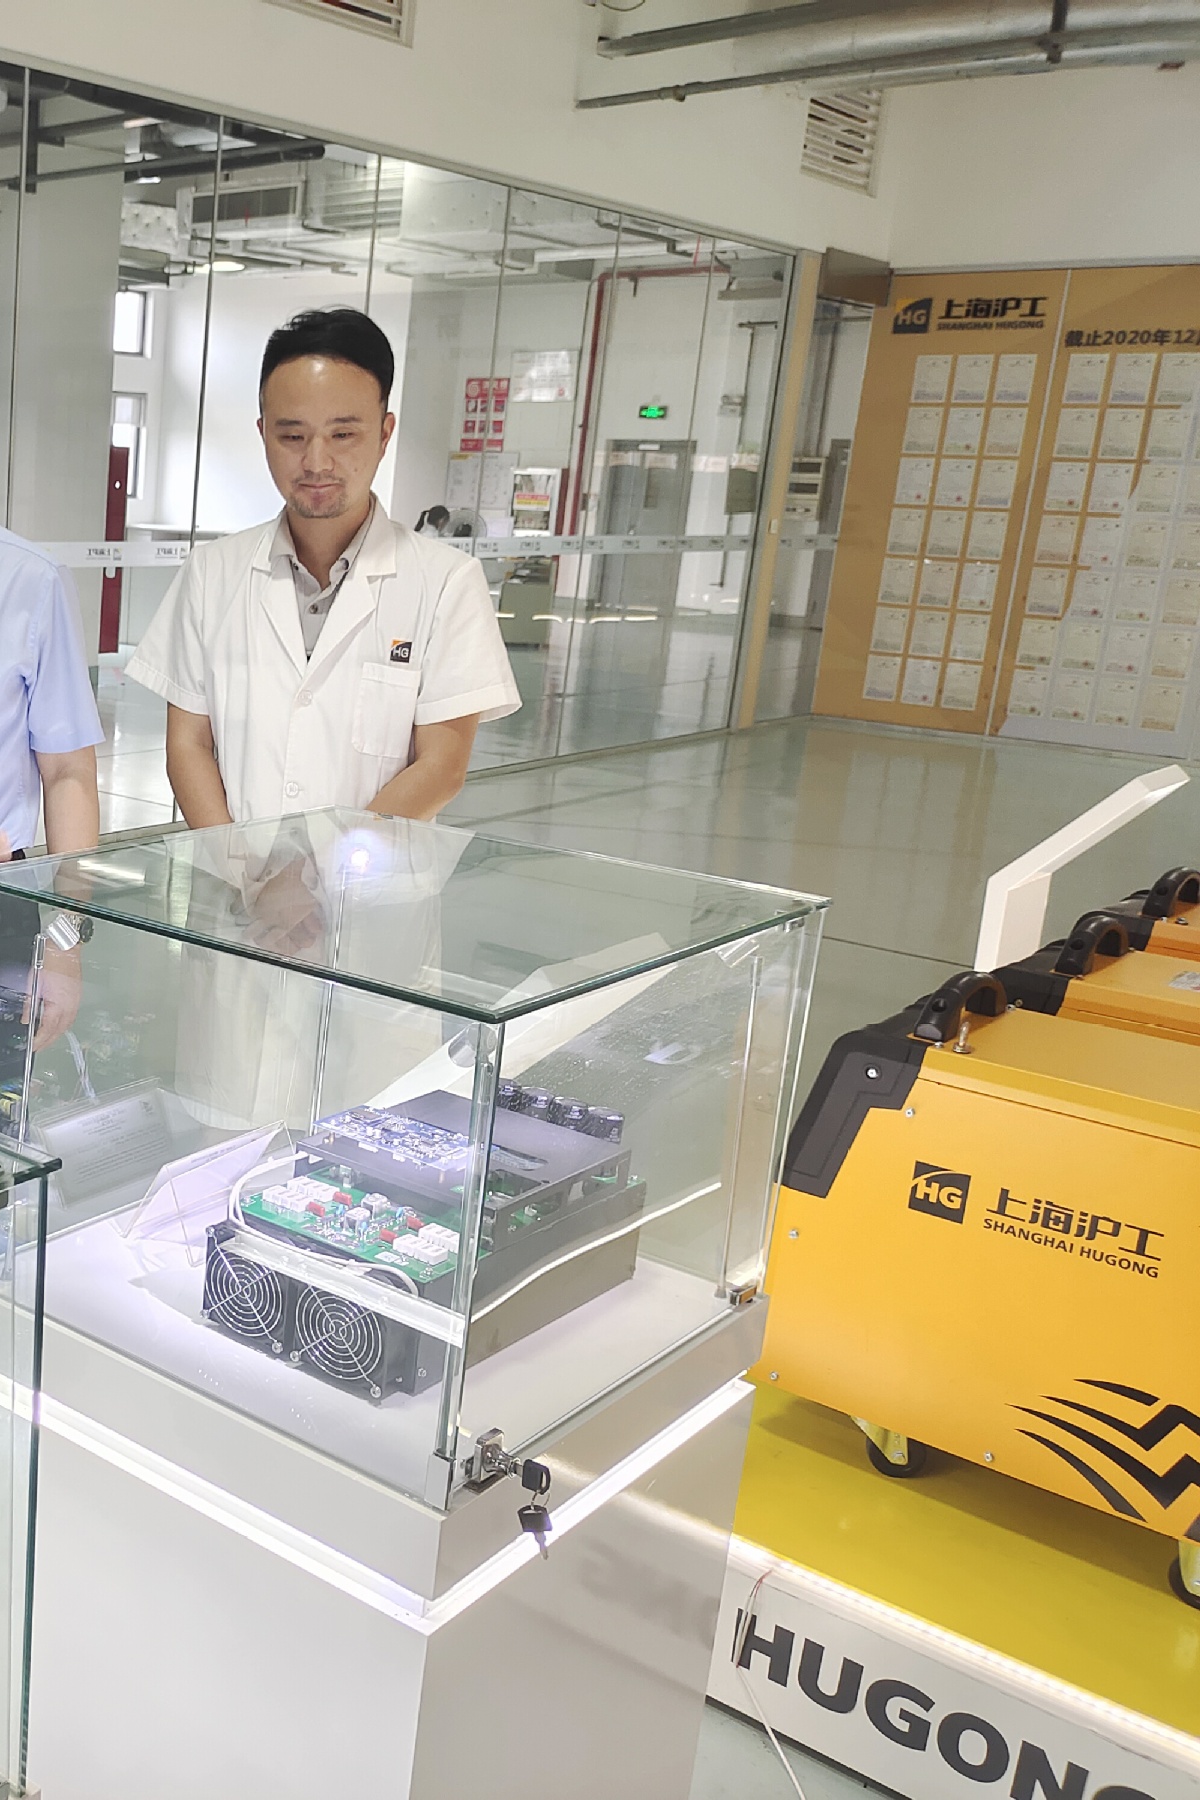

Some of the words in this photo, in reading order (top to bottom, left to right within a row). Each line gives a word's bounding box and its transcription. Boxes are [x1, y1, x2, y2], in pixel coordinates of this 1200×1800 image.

[938, 297, 1047, 319] 上海沪工
[1065, 328, 1200, 348] 截止2020年12
[392, 646, 410, 659] HG
[914, 1178, 964, 1210] HG
[986, 1187, 1165, 1262] 上海沪工
[983, 1217, 1074, 1254] SHANGHAI
[1079, 1246, 1160, 1279] HUGONG
[731, 1608, 1158, 1800] HUGON
